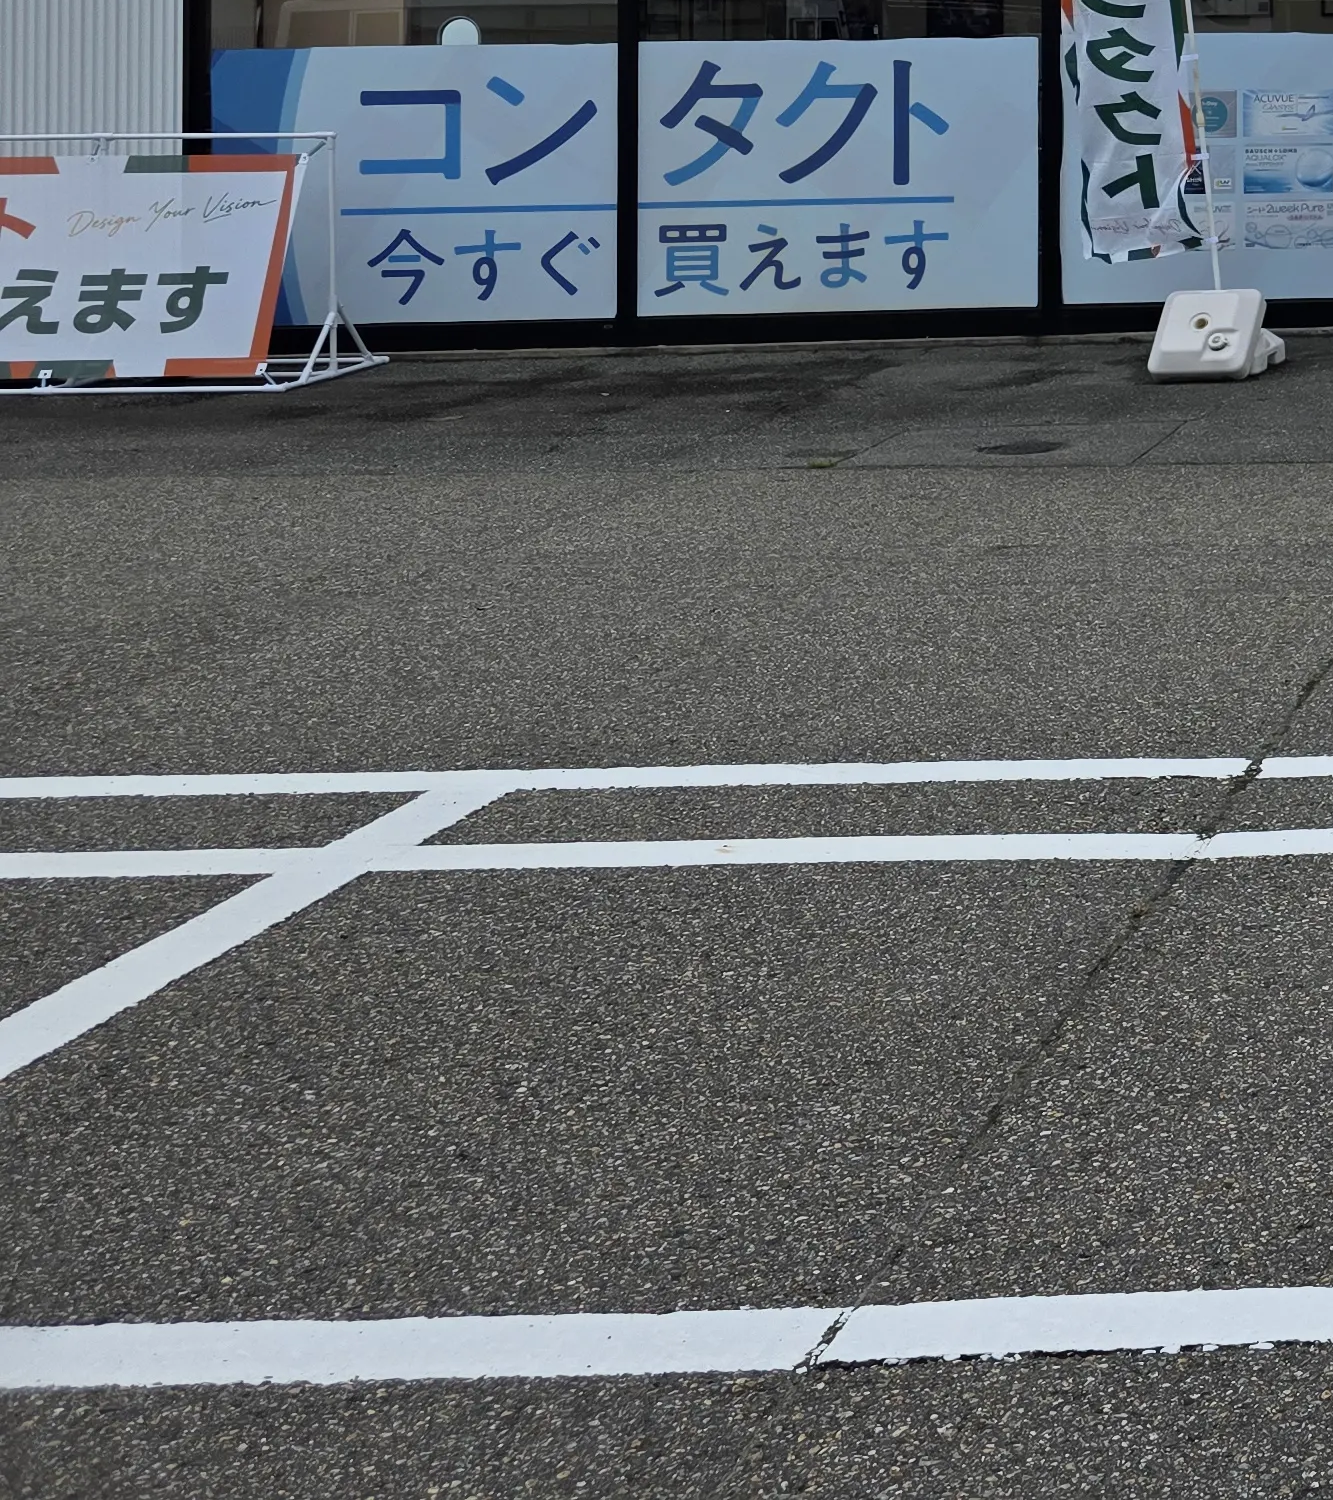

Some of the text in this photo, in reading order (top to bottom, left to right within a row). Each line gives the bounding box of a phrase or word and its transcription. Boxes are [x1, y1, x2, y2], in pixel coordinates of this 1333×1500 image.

[359, 59, 951, 187] コンタクト
[1253, 94, 1294, 103] ACUVUE
[67, 192, 277, 238] Design Your Vision
[0, 265, 230, 335] えます
